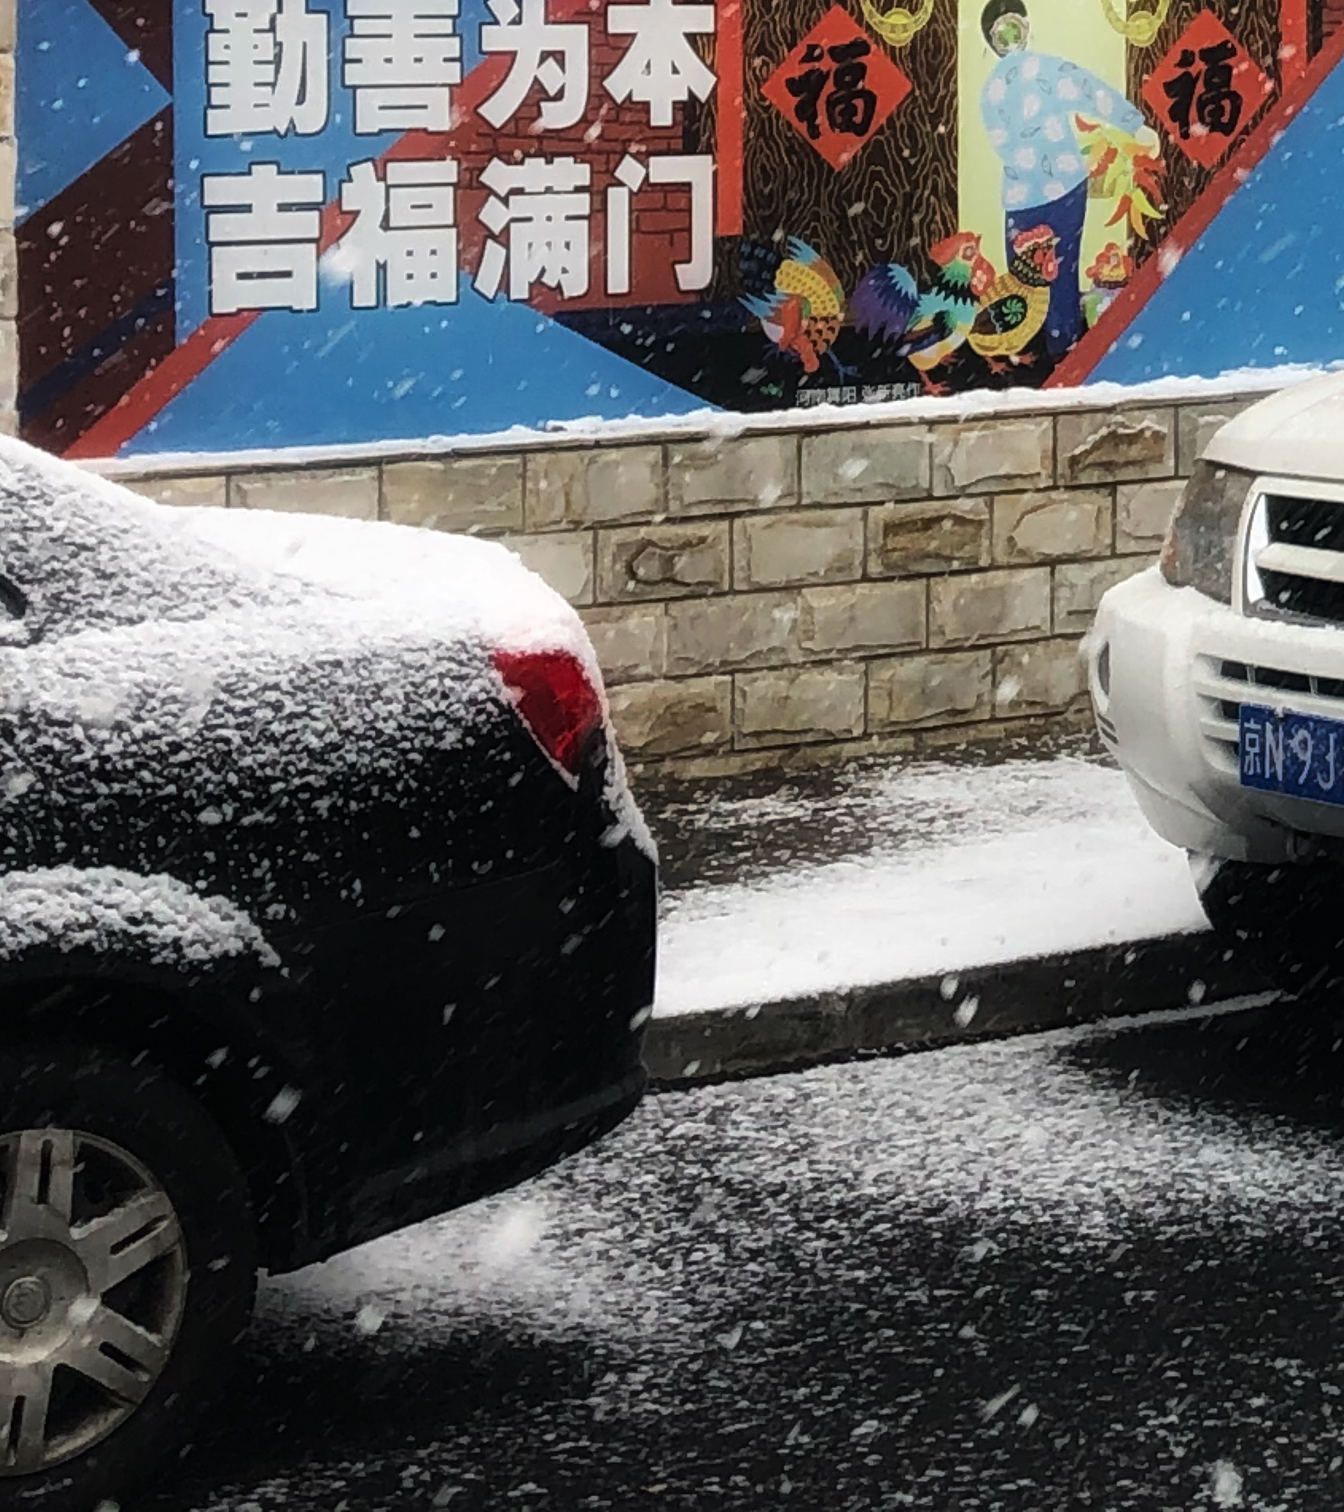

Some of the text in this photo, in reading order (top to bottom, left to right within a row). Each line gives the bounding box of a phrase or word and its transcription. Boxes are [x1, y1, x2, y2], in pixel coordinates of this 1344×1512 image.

[784, 36, 877, 140] 福
[1162, 38, 1243, 141] 福
[203, 154, 716, 313] 吉福满门
